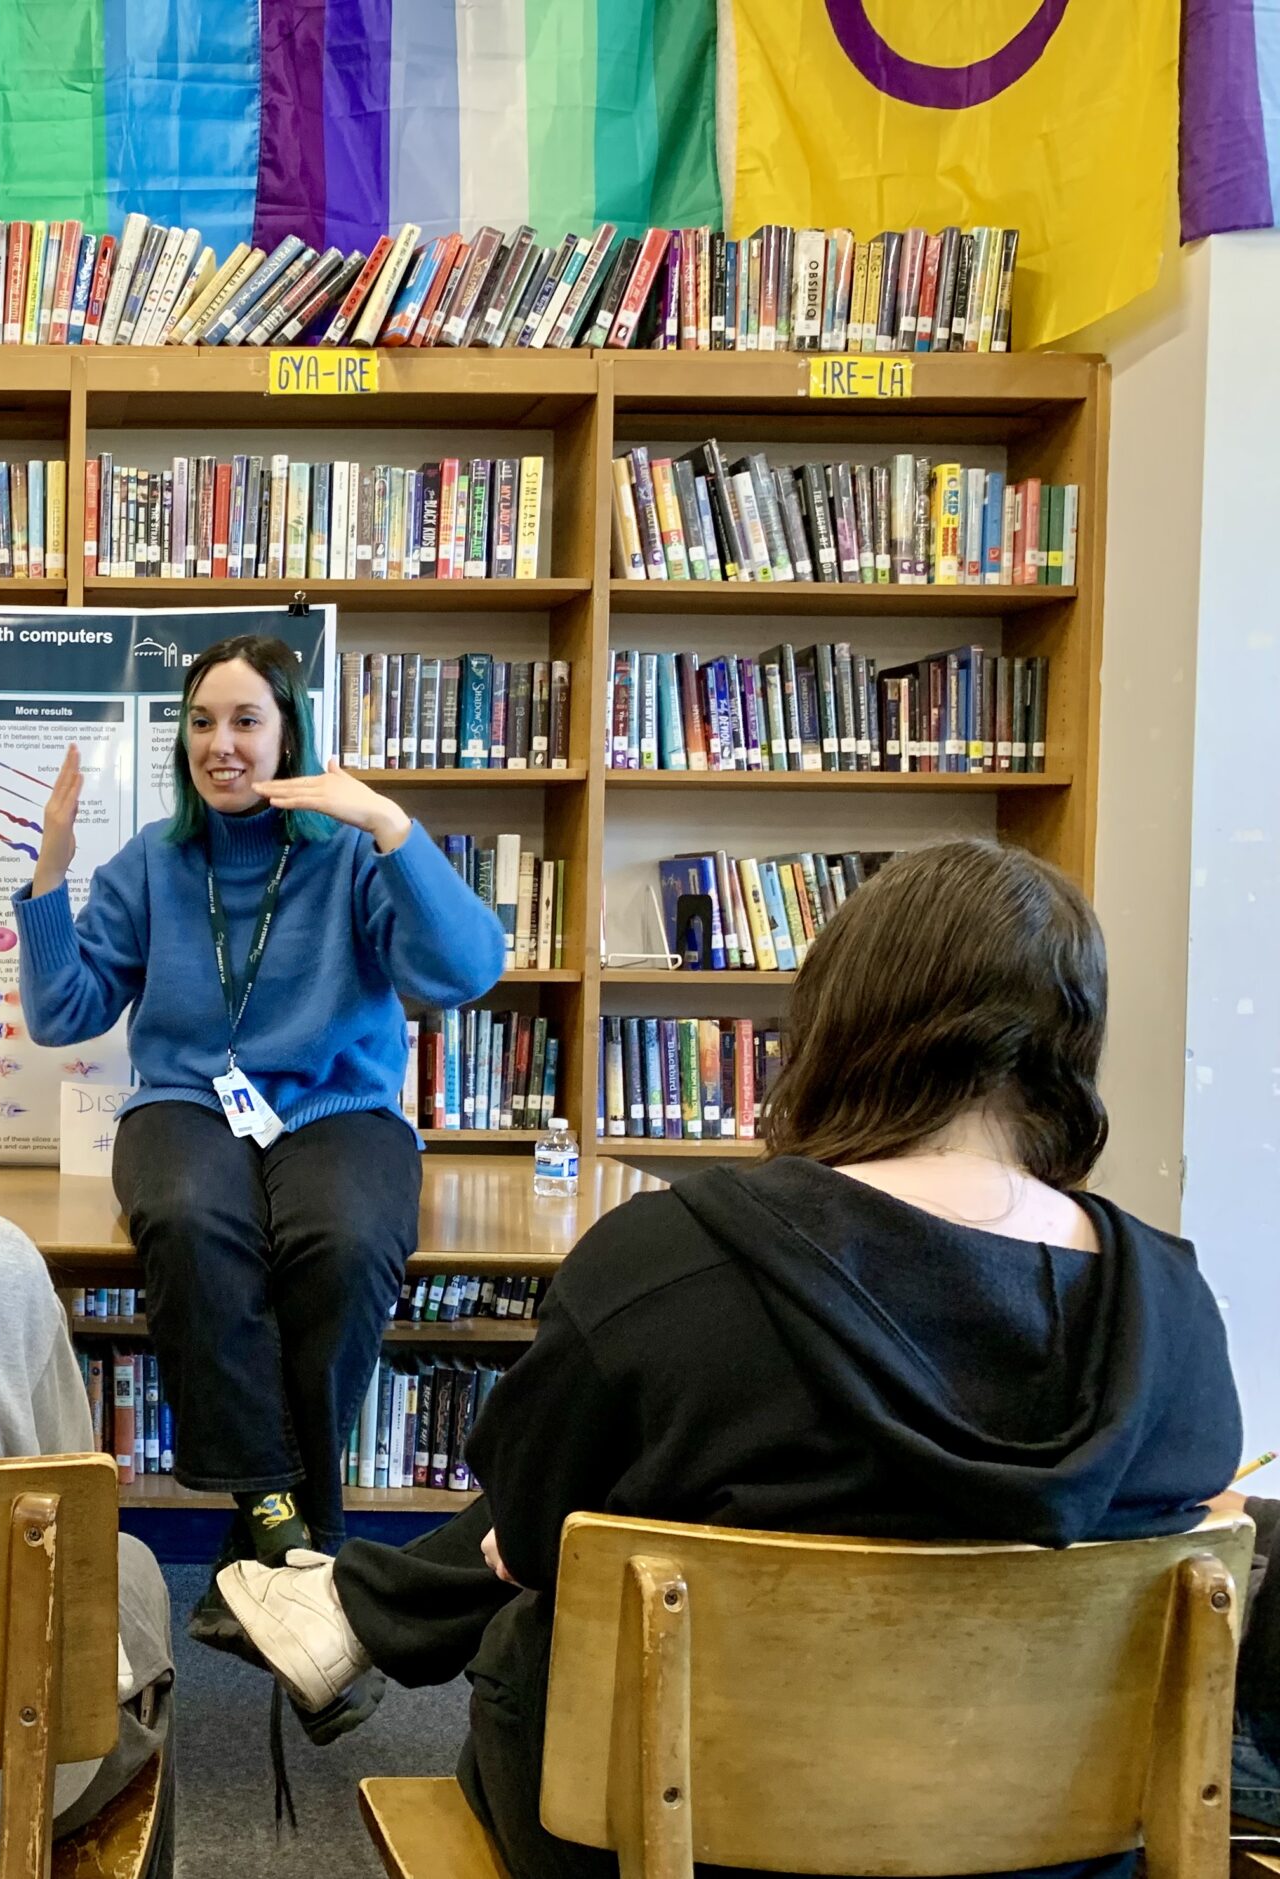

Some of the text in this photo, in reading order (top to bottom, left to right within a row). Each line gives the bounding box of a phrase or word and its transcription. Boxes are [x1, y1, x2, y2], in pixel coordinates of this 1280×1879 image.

[277, 358, 371, 393] GYA-IRE
[822, 361, 904, 397] IRE-LA
[422, 500, 437, 547] BLACK KIDS
[19, 628, 113, 645] computers
[15, 706, 72, 716] More results
[258, 922, 269, 950] BERKELEY
[668, 1041, 677, 1091] Blackbird
